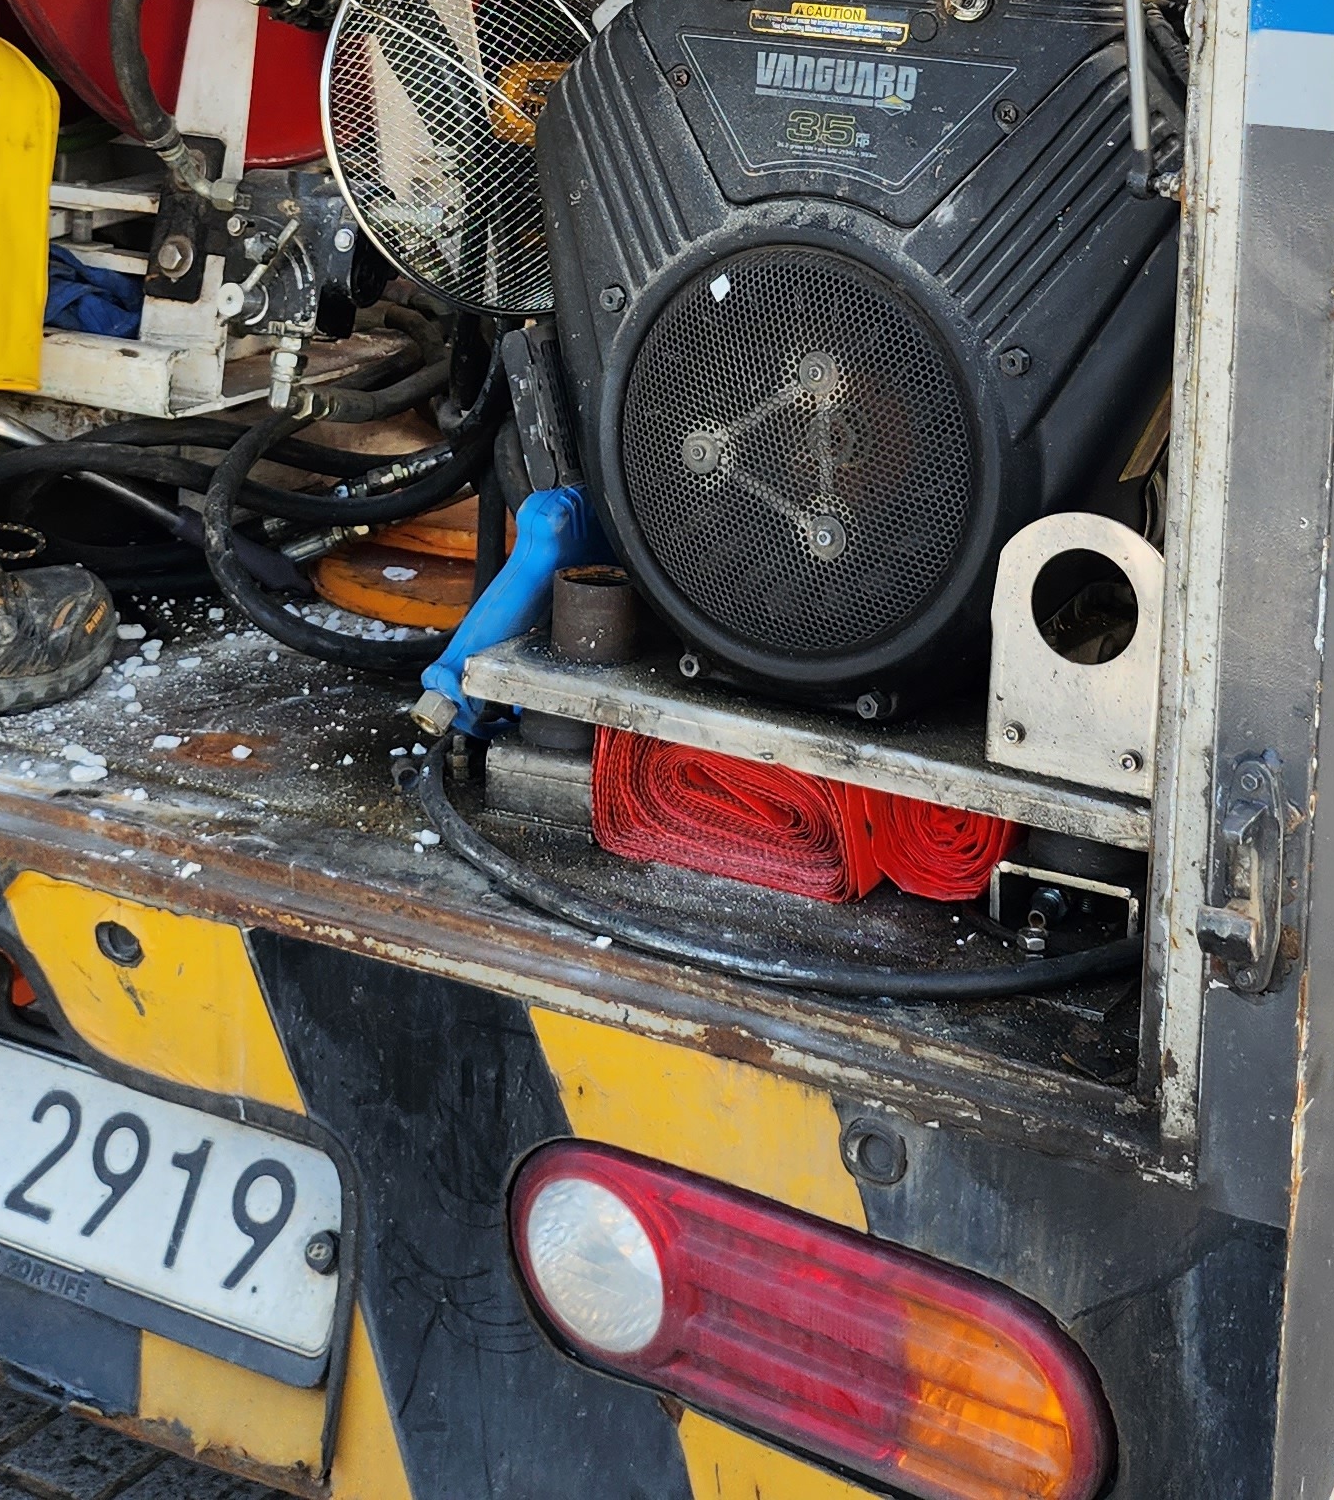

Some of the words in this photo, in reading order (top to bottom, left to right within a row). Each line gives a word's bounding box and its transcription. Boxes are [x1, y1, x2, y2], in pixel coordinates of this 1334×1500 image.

[807, 6, 861, 20] CAUTION
[756, 52, 918, 101] VANGUARD
[786, 110, 856, 147] 35
[855, 137, 870, 148] HP
[4, 1089, 297, 1291] 2919
[47, 1270, 91, 1302] LIFE
